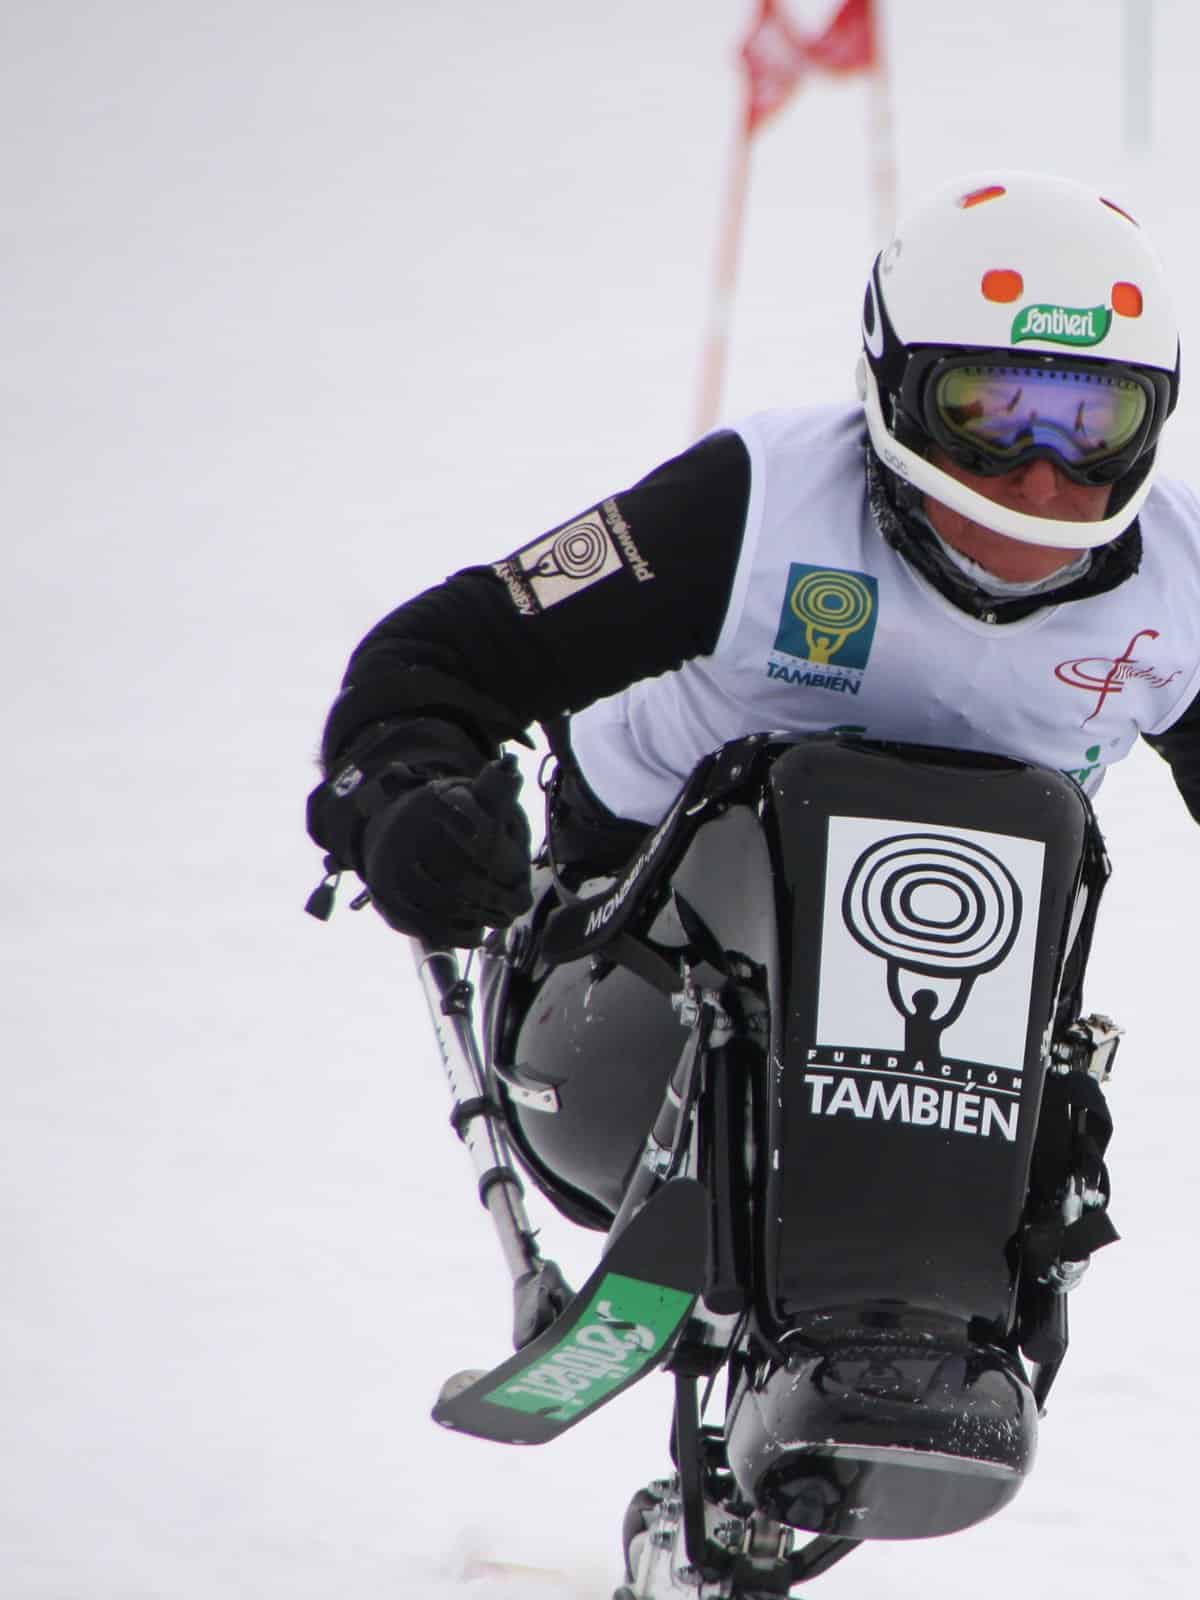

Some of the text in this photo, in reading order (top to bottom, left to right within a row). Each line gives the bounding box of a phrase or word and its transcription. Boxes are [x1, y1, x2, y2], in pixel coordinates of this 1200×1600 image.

[1020, 307, 1096, 338] Santiveri
[807, 1050, 1023, 1090] FUNDACIÓN
[803, 1073, 1021, 1143] TAMBIÉN
